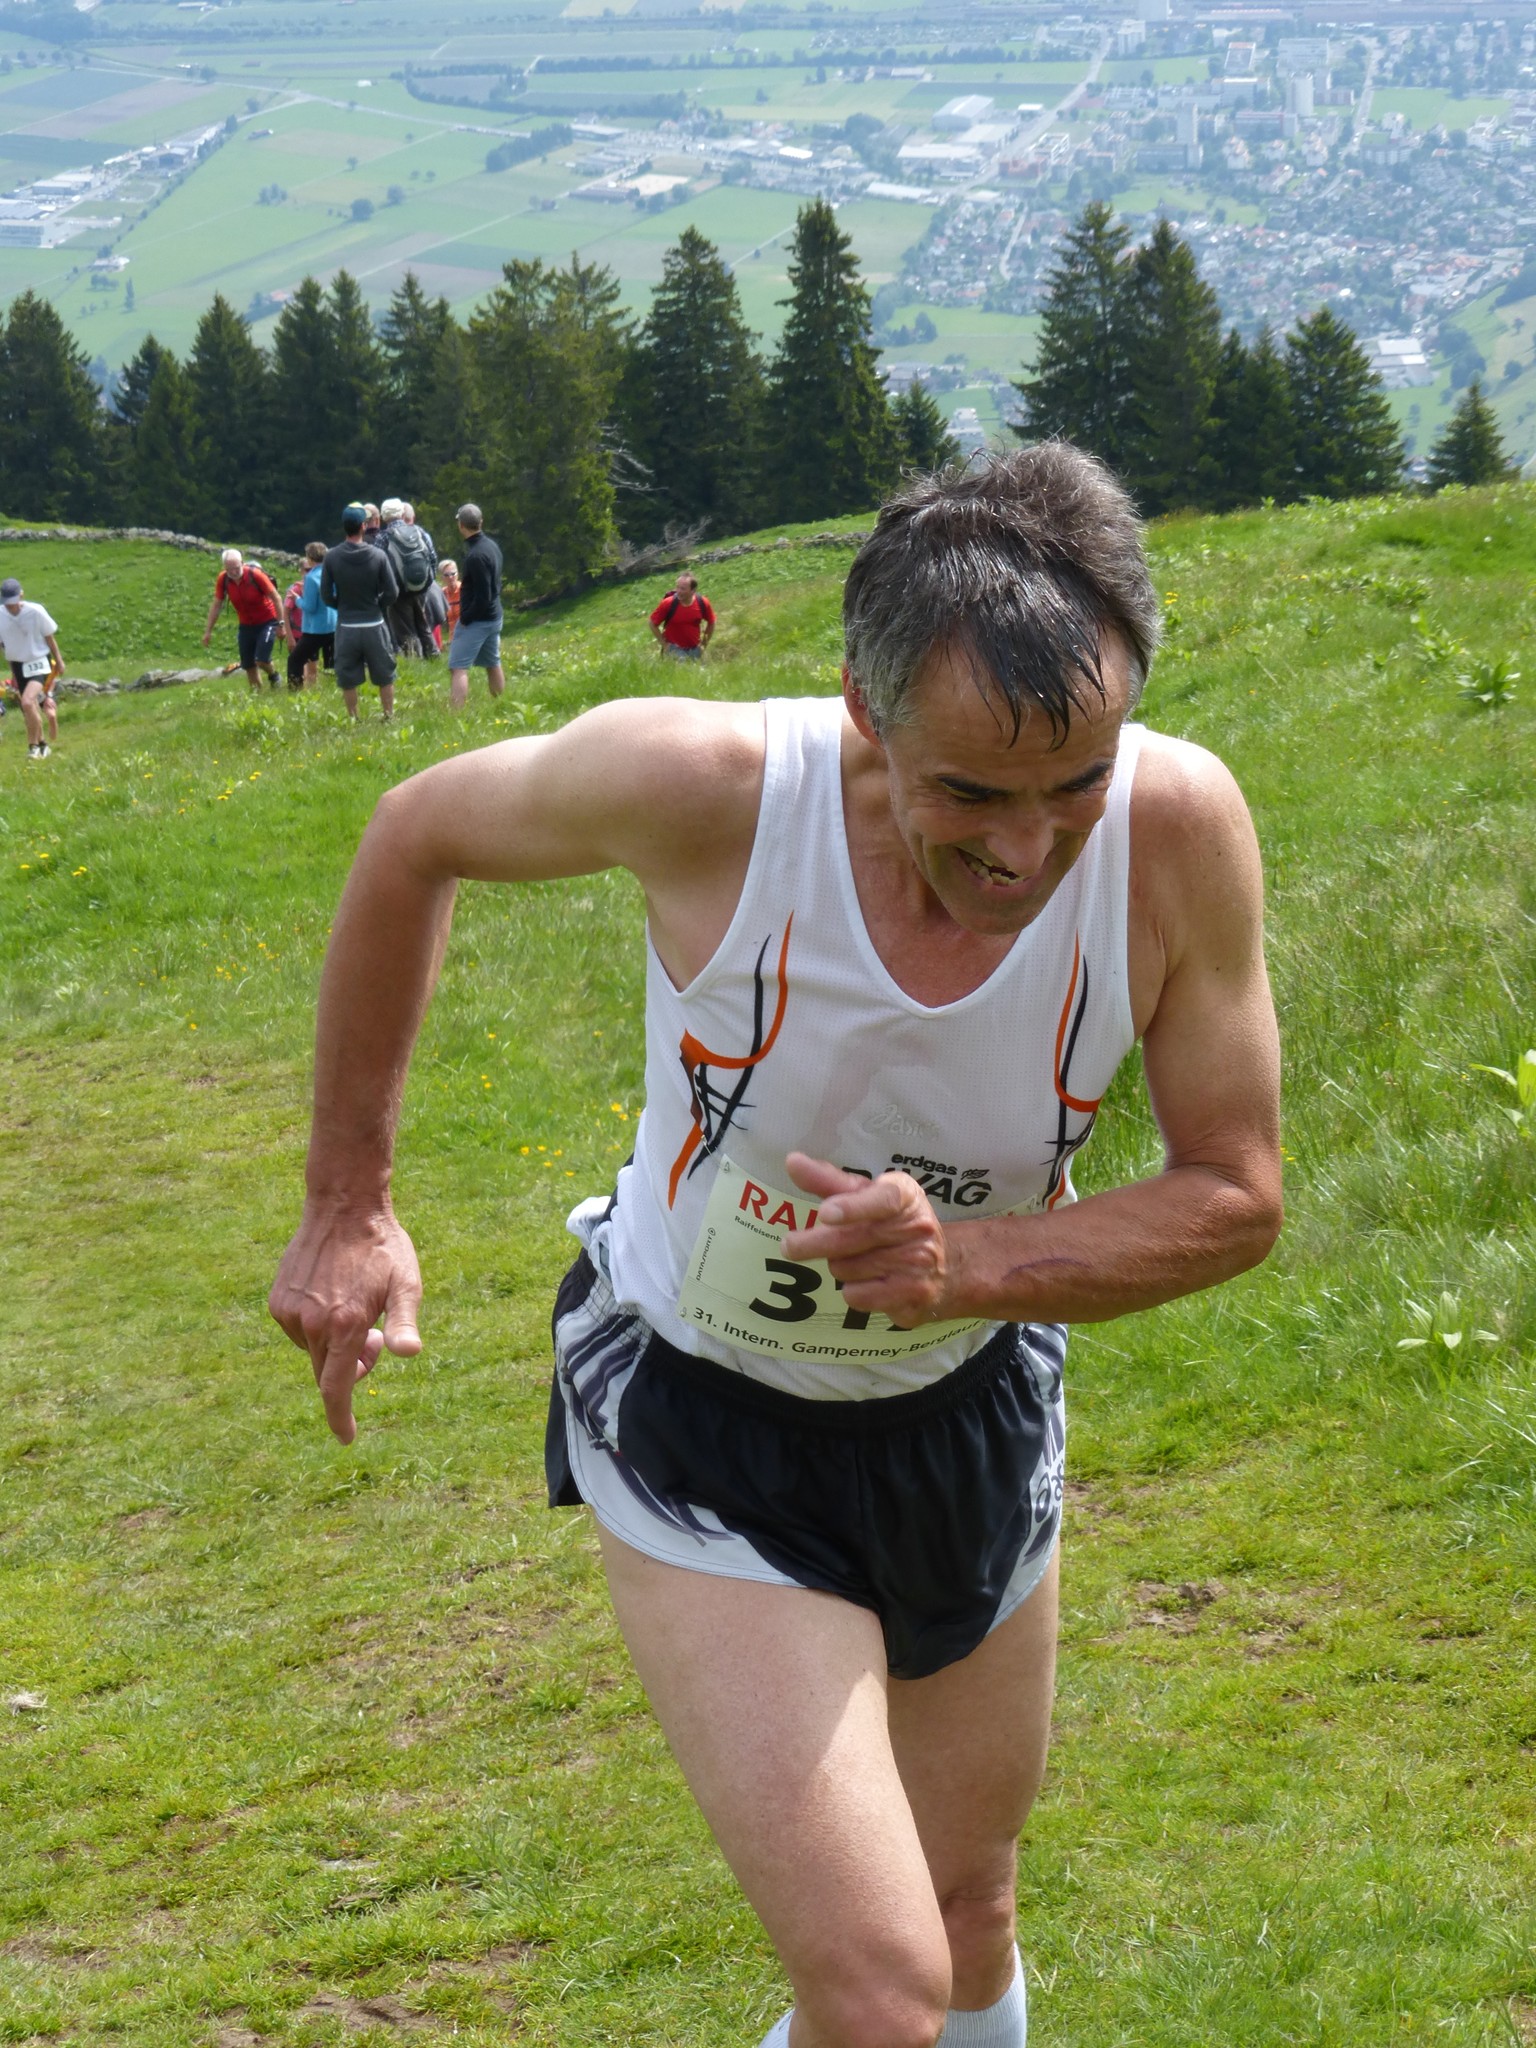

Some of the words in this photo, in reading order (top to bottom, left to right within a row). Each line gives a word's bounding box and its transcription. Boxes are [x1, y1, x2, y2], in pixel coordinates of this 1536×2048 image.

[891, 1153, 958, 1176] erdgas
[692, 1307, 718, 1328] 31.
[723, 1321, 785, 1350] Intern.
[791, 1320, 981, 1358] Gamperney-Berglauf
